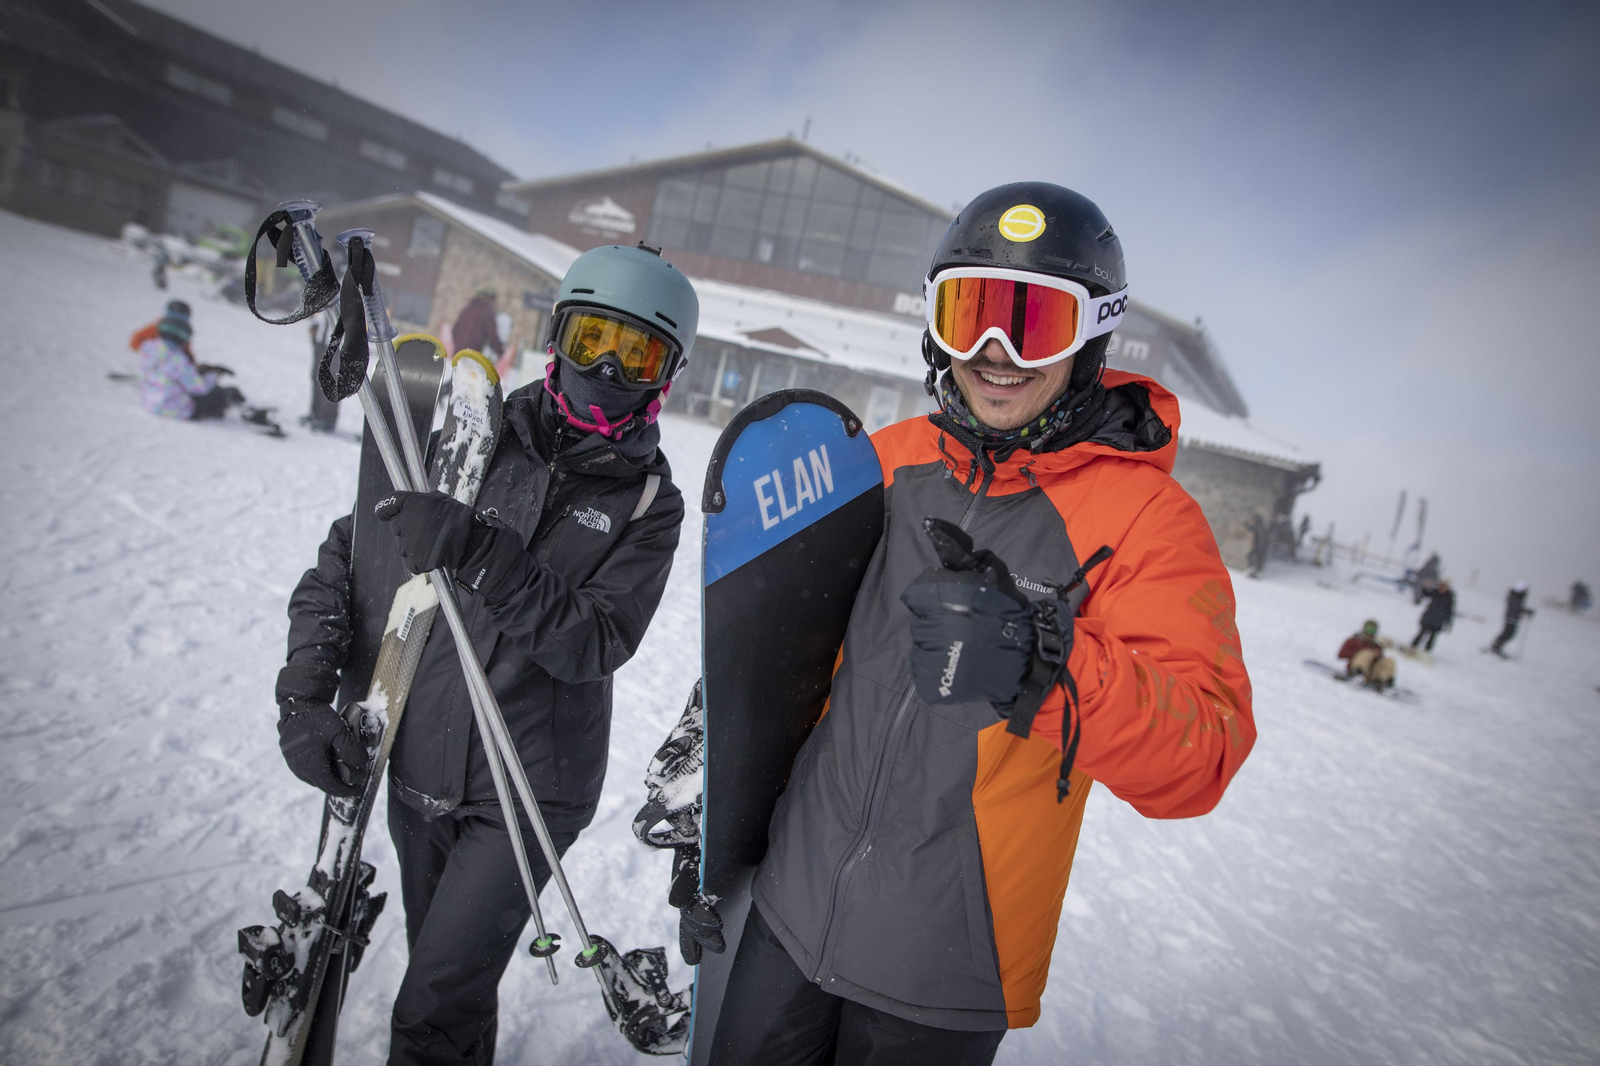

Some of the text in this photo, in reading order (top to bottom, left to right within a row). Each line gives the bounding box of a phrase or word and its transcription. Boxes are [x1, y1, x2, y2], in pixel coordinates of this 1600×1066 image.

[753, 444, 834, 531] ELAN
[573, 510, 600, 524] NORTH
[587, 507, 601, 516] THE
[578, 517, 596, 529] FACE
[940, 640, 964, 687] Columbia
